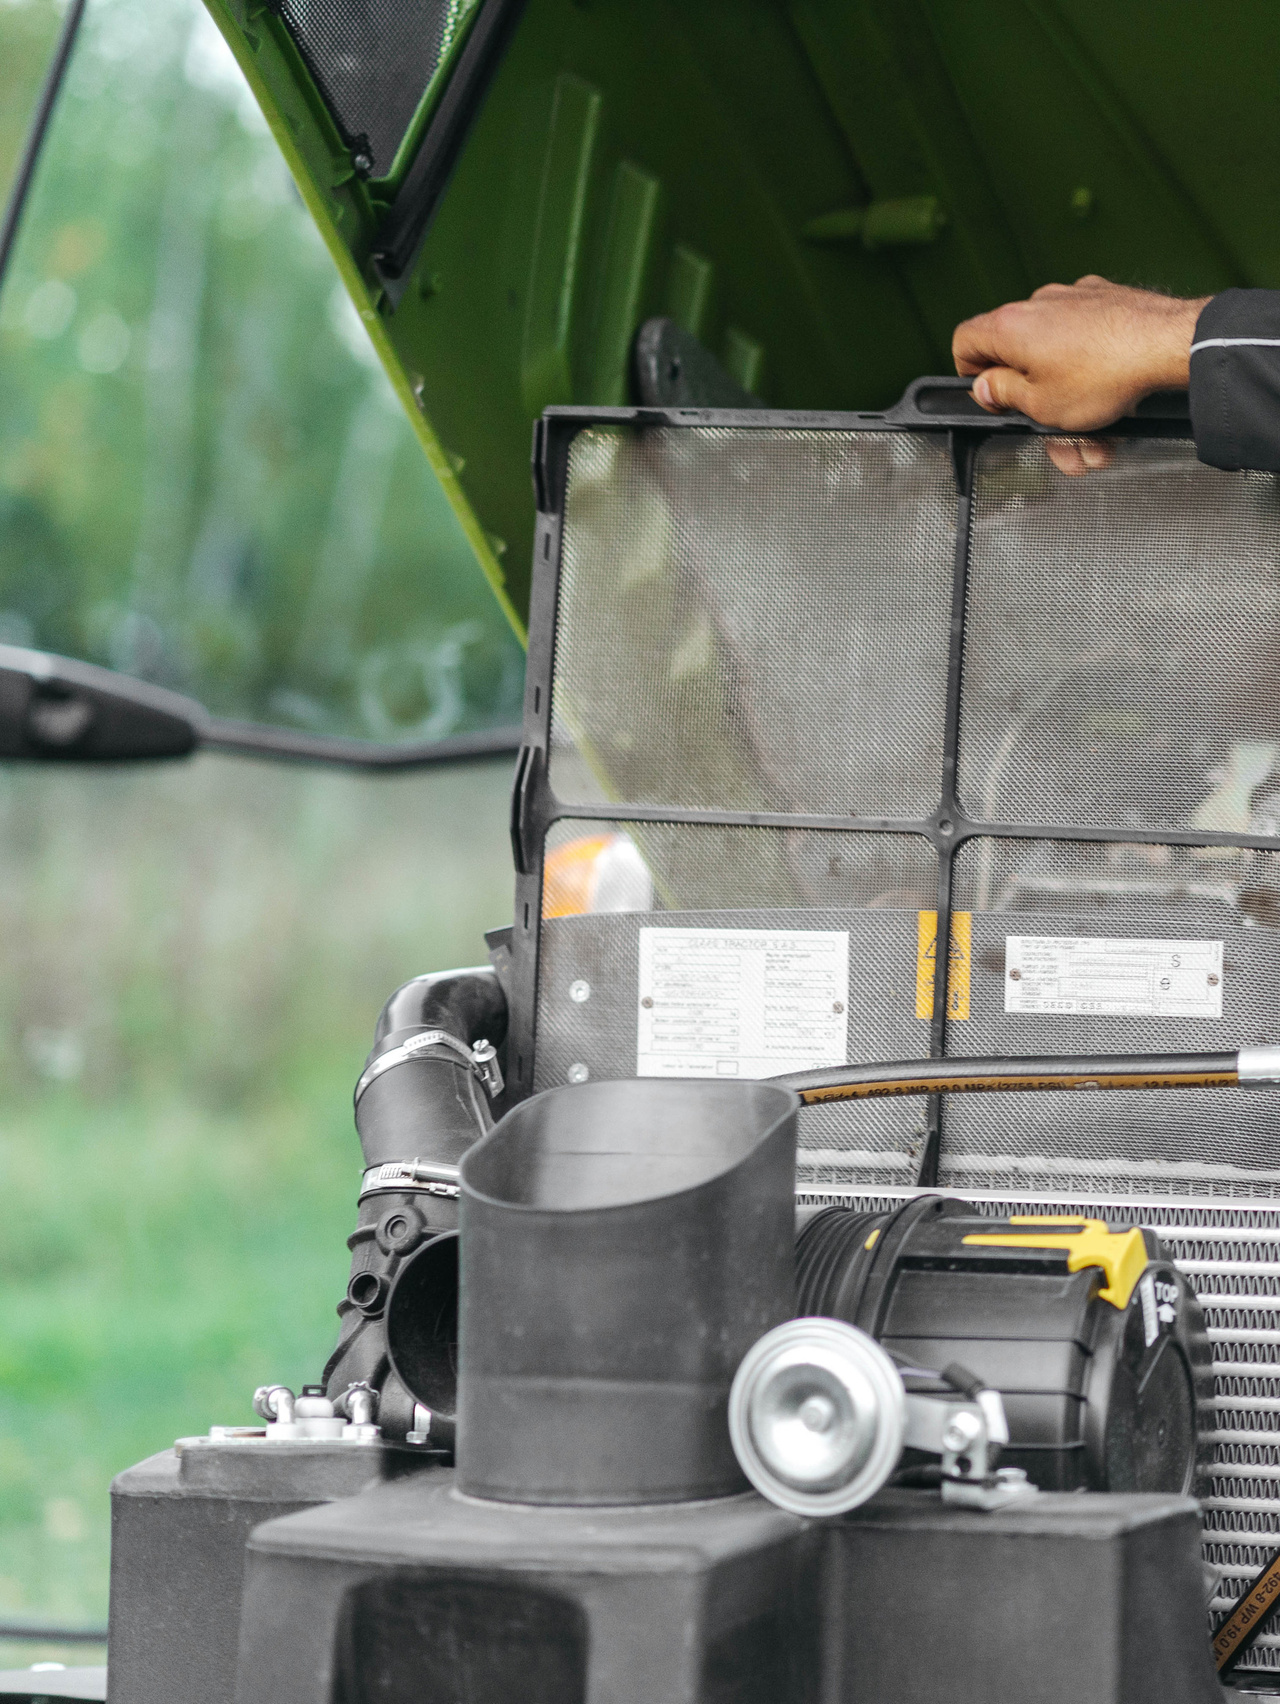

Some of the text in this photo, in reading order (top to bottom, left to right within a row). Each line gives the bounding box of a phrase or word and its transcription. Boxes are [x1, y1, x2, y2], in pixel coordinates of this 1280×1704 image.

[1154, 1281, 1179, 1304] TOP
[1241, 1603, 1260, 1625] WP
[1219, 1624, 1242, 1649] 19.0
